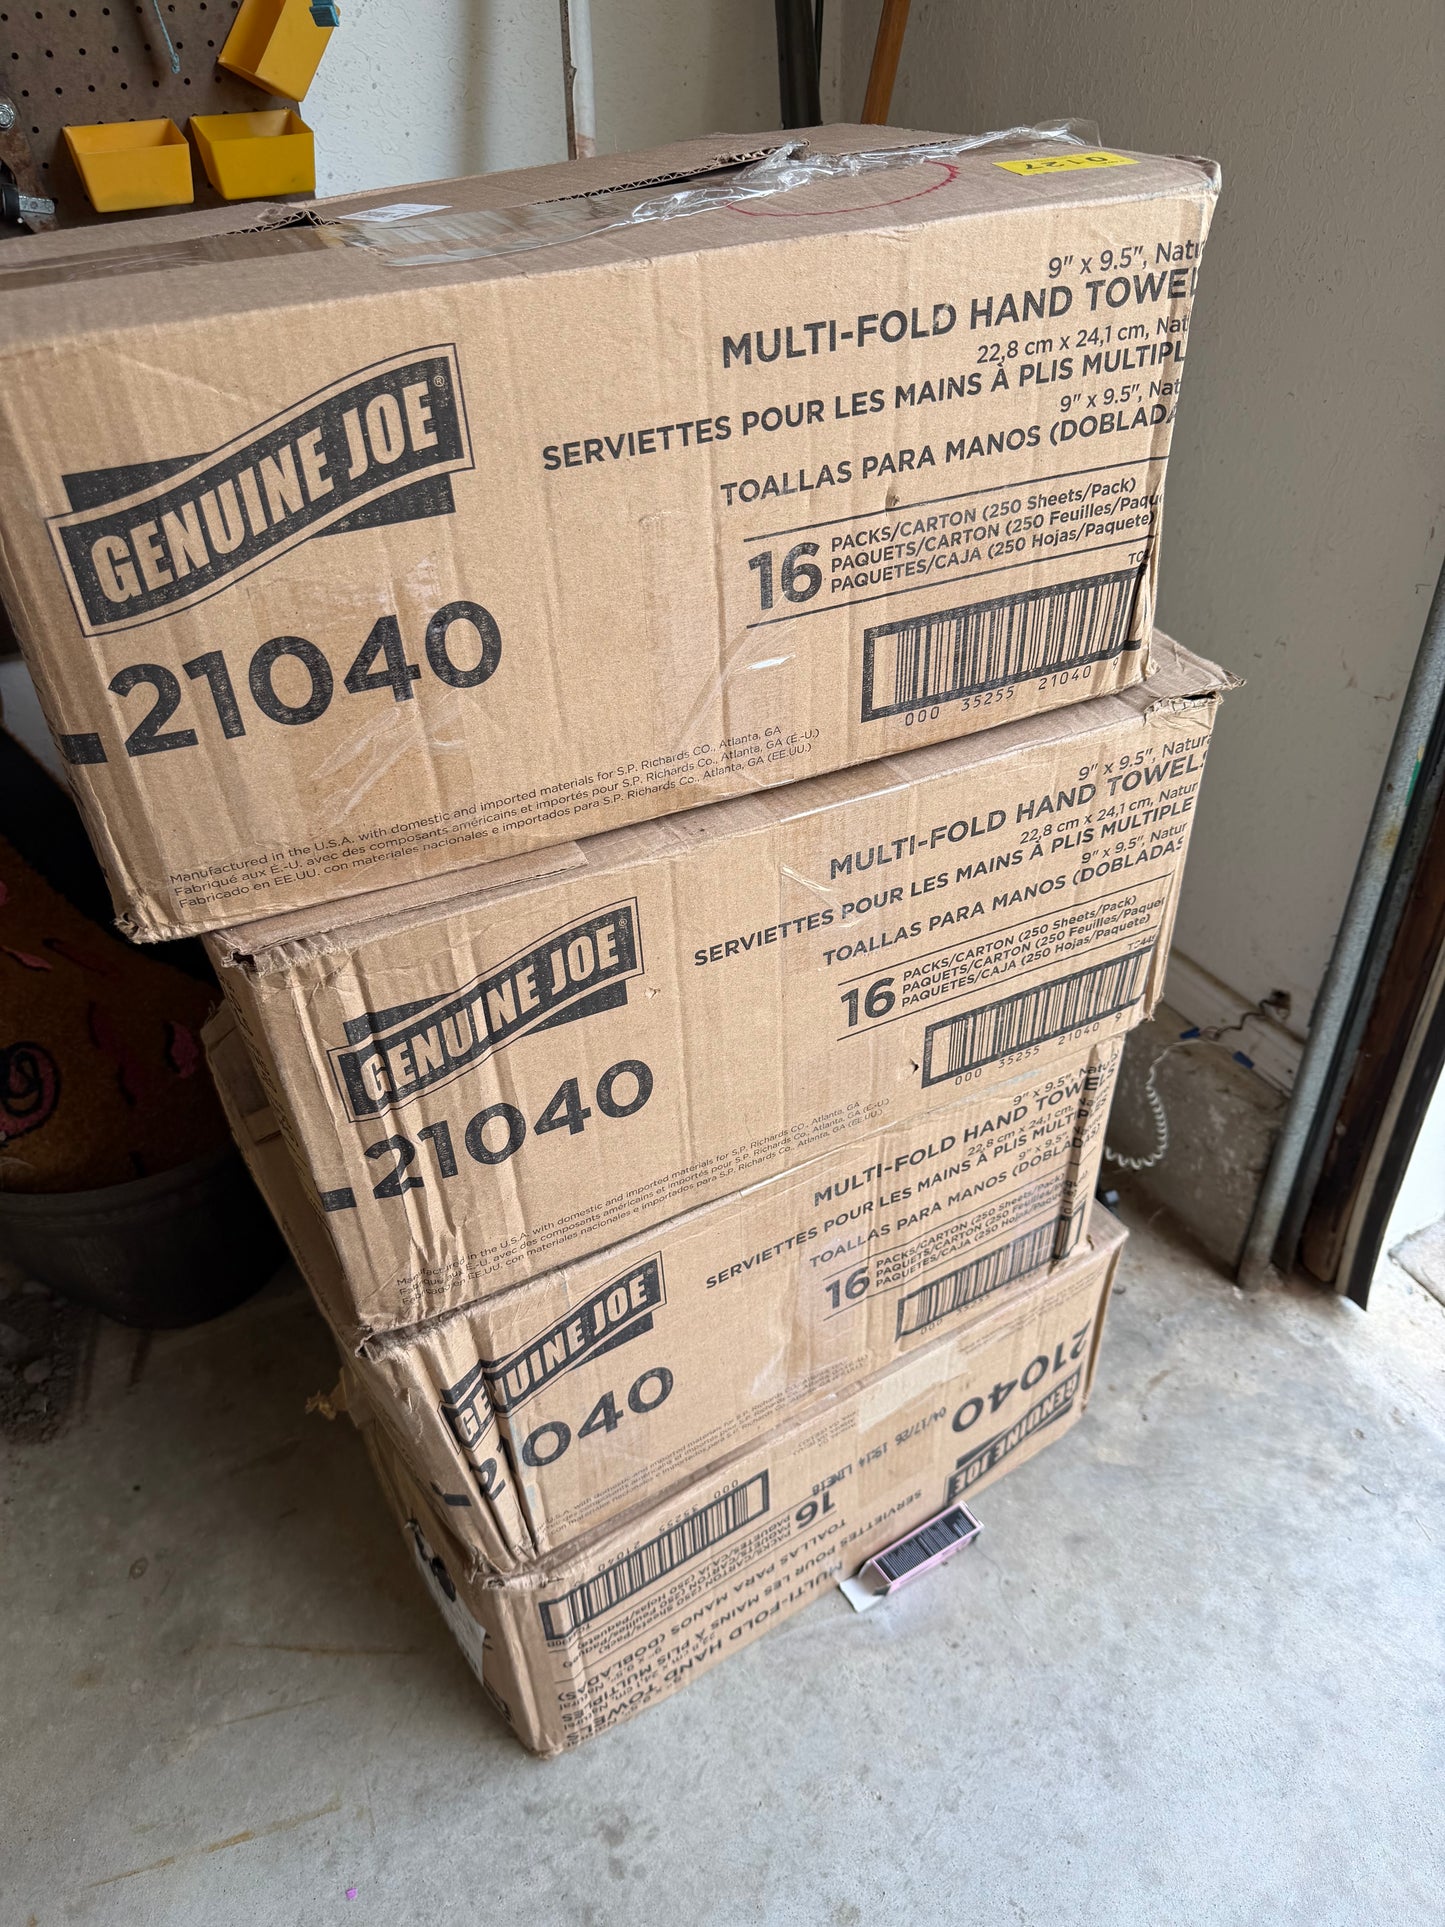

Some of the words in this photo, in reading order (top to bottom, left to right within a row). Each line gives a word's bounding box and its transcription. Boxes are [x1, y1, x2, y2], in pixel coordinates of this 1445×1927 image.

[1048, 254, 1073, 279] 9"
[1079, 256, 1092, 275] x
[1099, 245, 1147, 272] 9.5",
[722, 302, 957, 369] MULTI-FOLD
[970, 285, 1073, 330] HAND
[976, 340, 1018, 364] 22,8
[1024, 338, 1053, 356] cm
[1058, 335, 1070, 351] x
[1075, 324, 1111, 348] 24,1
[1117, 323, 1149, 341] cm,
[542, 415, 732, 471] SERVIETTES
[742, 399, 824, 436] POUR
[835, 388, 885, 419] LES
[894, 372, 982, 409] MAINS
[990, 363, 1009, 392] À
[1018, 357, 1073, 387] PLIS
[1060, 392, 1081, 413] 9"
[1086, 394, 1097, 409] x
[1103, 383, 1142, 405] 9.5",
[719, 460, 852, 506] TOALLAS
[862, 444, 936, 479] PARA
[945, 424, 1041, 463] MANOS
[90, 426, 336, 602] GENUINE
[831, 507, 976, 552] PACKS/CARTON
[982, 498, 1021, 522] (250
[1027, 476, 1136, 510] Sheets/Pack)
[831, 522, 999, 573] PAQUETS/CARTON
[1005, 513, 1044, 537] (250
[748, 542, 823, 611] 16
[831, 546, 981, 593] PAQUETES/CAJA
[987, 536, 1026, 560] (250
[1031, 507, 1157, 548] Hojas/Paquete)
[107, 599, 501, 757] 21040
[905, 705, 939, 727] 000
[961, 685, 1014, 711] 35255
[1038, 664, 1092, 691] 21040
[1078, 762, 1098, 781] 9"
[1102, 762, 1114, 775] x
[1119, 747, 1155, 764] 9.5",
[169, 854, 268, 884] Manufactured
[271, 852, 284, 861] in
[288, 846, 311, 857] the
[313, 837, 355, 856] U.S.A.
[357, 827, 387, 841] with
[390, 812, 450, 834] domestic
[453, 803, 477, 819] and
[480, 788, 536, 811] imported
[539, 776, 594, 796] materials
[596, 770, 614, 781] for
[616, 763, 638, 776] S.P.
[640, 750, 690, 770] Richards
[692, 744, 715, 756] CO.,
[719, 733, 761, 749] Atlanta,
[764, 725, 781, 737] GA
[173, 874, 238, 896] Fabriqué
[241, 869, 267, 882] aux
[269, 859, 303, 875] É.-U.
[306, 850, 339, 865] avec
[341, 844, 366, 858] des
[369, 827, 449, 851] composants
[452, 808, 517, 832] américains
[520, 803, 533, 814] et
[535, 790, 589, 810] importés
[591, 782, 619, 797] pour
[622, 775, 643, 788] S.P.
[646, 761, 694, 780] Richards
[697, 757, 718, 768] Co.,
[720, 745, 762, 762] Atlanta,
[765, 738, 783, 750] GA
[785, 728, 820, 745] (É.-U.)
[830, 809, 1006, 880] MULTI-FOLD
[1016, 783, 1096, 824] HAND
[1019, 823, 1052, 845] 22,8
[1056, 818, 1079, 833] cm
[1083, 813, 1093, 824] x
[1096, 802, 1125, 822] 24,1
[1128, 797, 1153, 811] cm,
[694, 908, 834, 966] SERVIETTES
[841, 886, 903, 920] POUR
[910, 872, 948, 897] LES
[955, 849, 1023, 883] MAINS
[1029, 841, 1044, 860] À
[1051, 827, 1095, 853] PLIS
[822, 921, 921, 966] TOALLAS
[928, 901, 985, 931] PARA
[992, 874, 1066, 911] MANOS
[902, 941, 1031, 994] PAQUETS/CARTON
[1035, 930, 1065, 949] (250
[903, 935, 1014, 981] PACKS/CARTON
[1018, 923, 1048, 943] (250
[1052, 894, 1137, 930] Sheets/Pack)
[362, 963, 540, 1101] GENUINE
[840, 977, 895, 1027] 16
[955, 1068, 982, 1085] 000
[999, 1045, 1040, 1068] 35255
[1058, 1022, 1099, 1046] 21040
[364, 1059, 653, 1199] 21040
[814, 1135, 956, 1207] MULTI-FOLD
[963, 1105, 1028, 1143] HAND
[706, 1226, 818, 1289] SERVIETTES
[824, 1201, 873, 1233] POUR
[879, 1186, 912, 1208] LES
[917, 1159, 971, 1192] MAINS
[976, 1151, 988, 1166] À
[993, 1134, 1027, 1158] PLIS
[809, 1223, 890, 1267] TOALLAS
[896, 1203, 942, 1231] PARA
[947, 1171, 1007, 1206] MANOS
[824, 1267, 870, 1309] 16
[780, 1519, 846, 1564] TOALLAS
[795, 1491, 836, 1531] 16
[840, 1489, 922, 1548] SERVIETTES
[734, 1564, 775, 1593] PARA
[764, 1575, 791, 1596] LES
[795, 1546, 836, 1577] POUR
[670, 1592, 728, 1634] MANOS
[711, 1595, 760, 1630] MAINS
